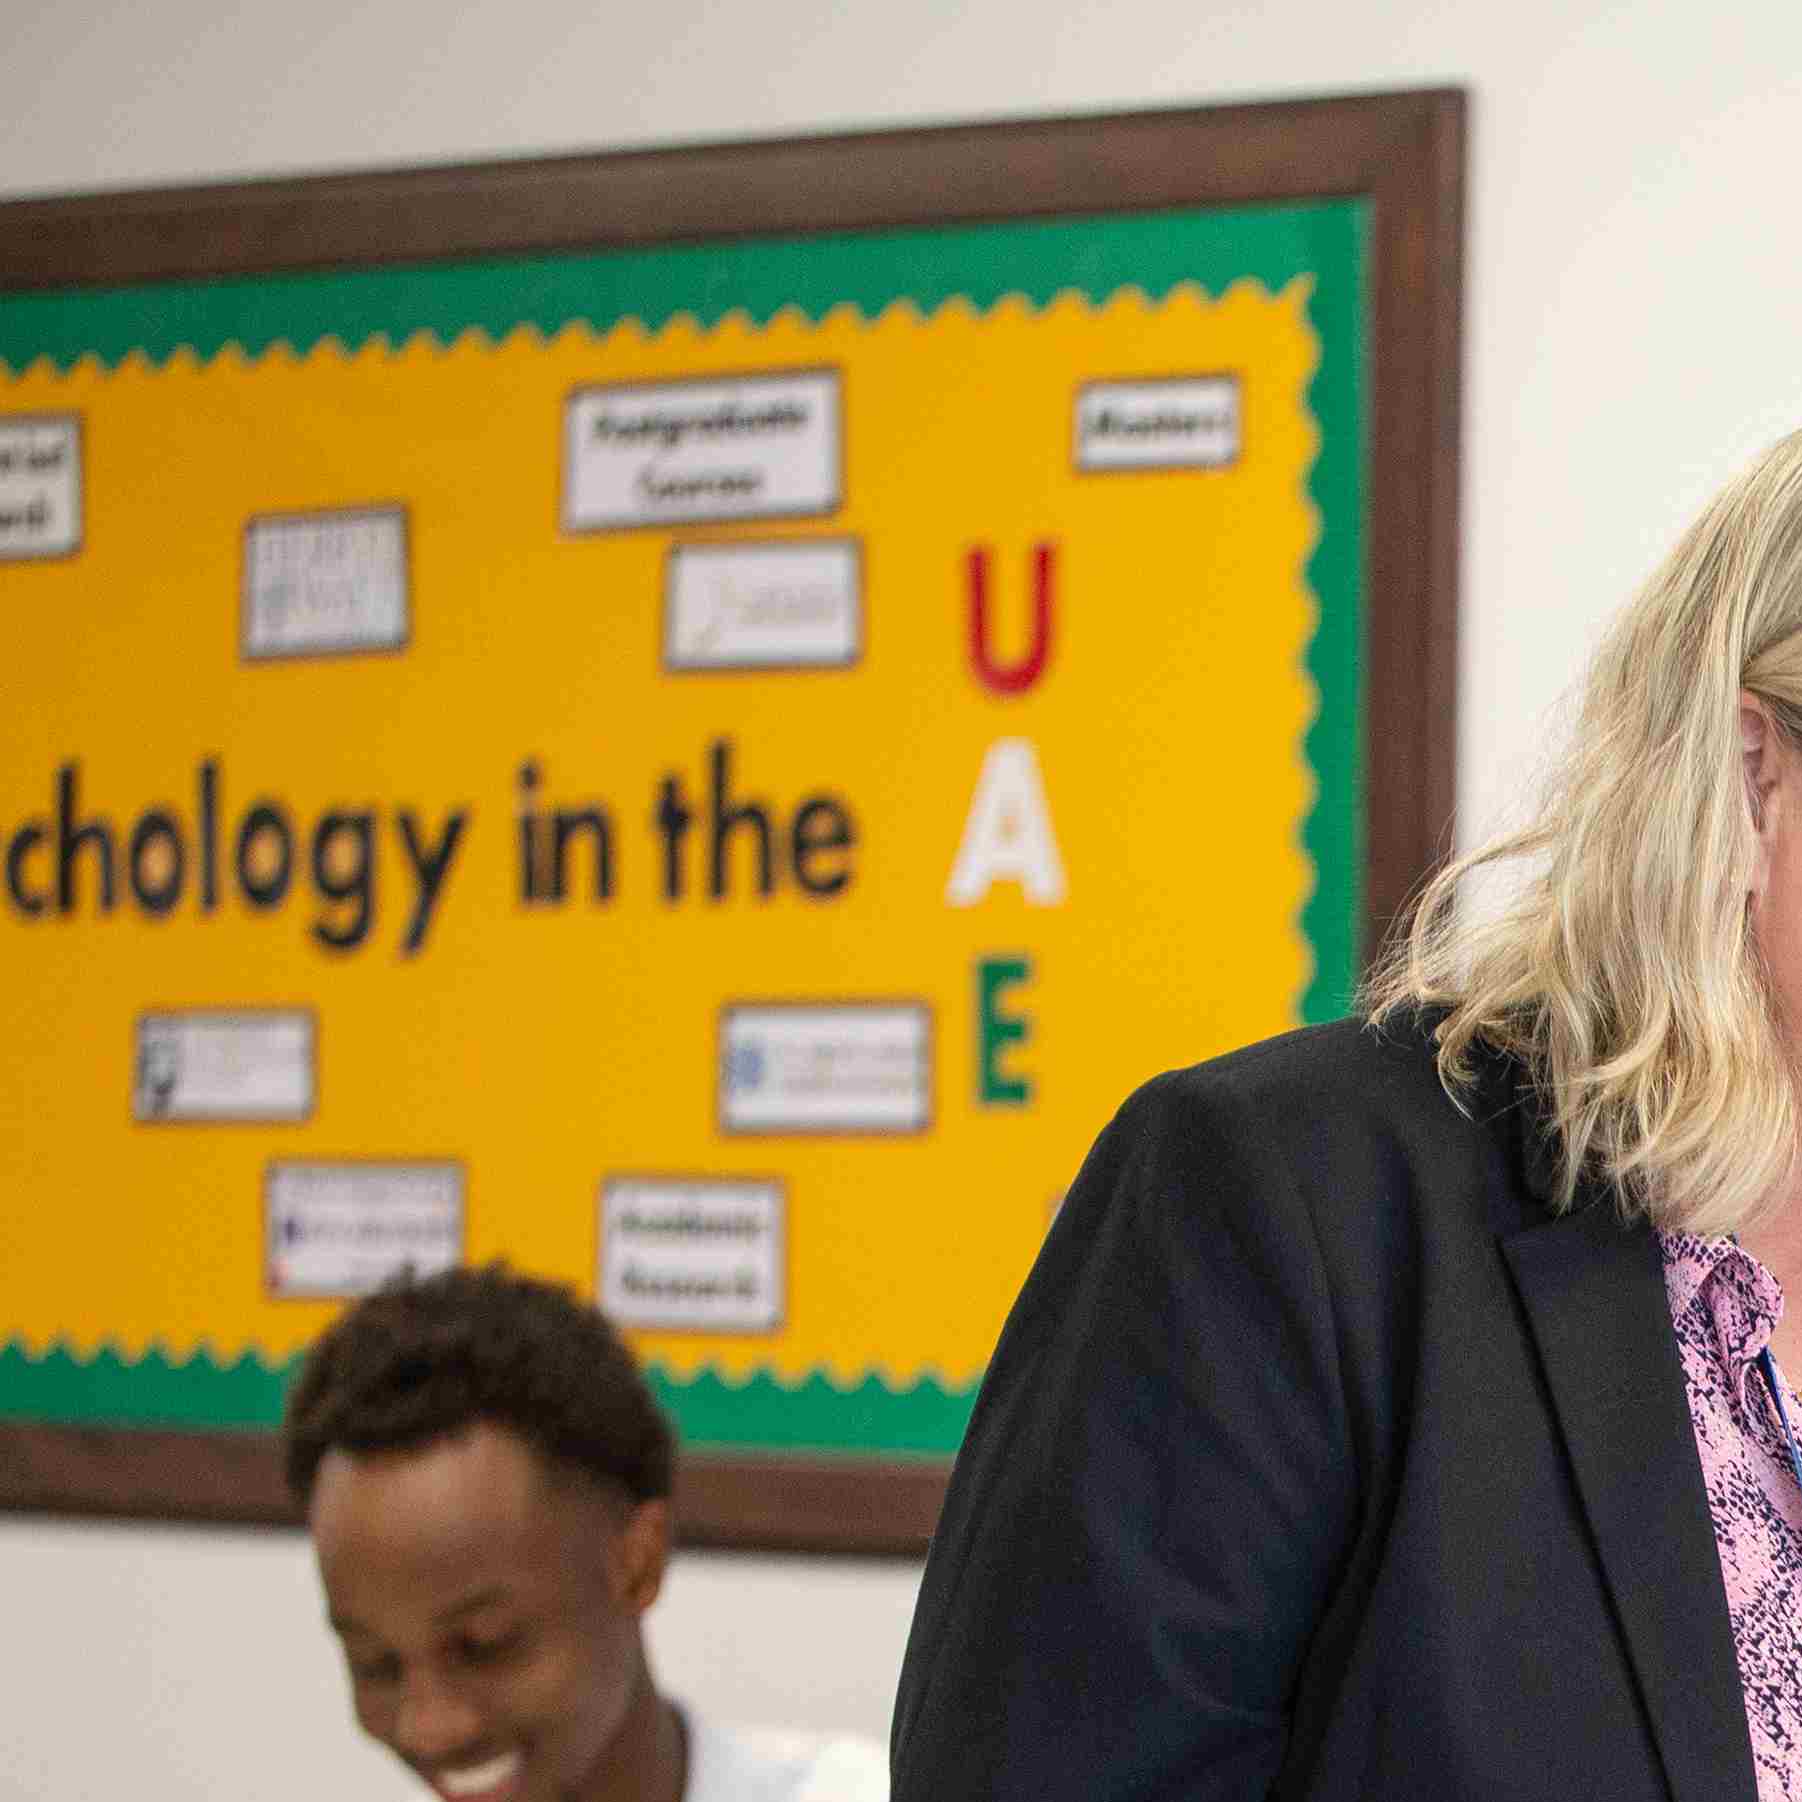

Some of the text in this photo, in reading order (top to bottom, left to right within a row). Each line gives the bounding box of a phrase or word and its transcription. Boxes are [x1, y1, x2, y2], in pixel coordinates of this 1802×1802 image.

[4, 738, 857, 955] chology in the
